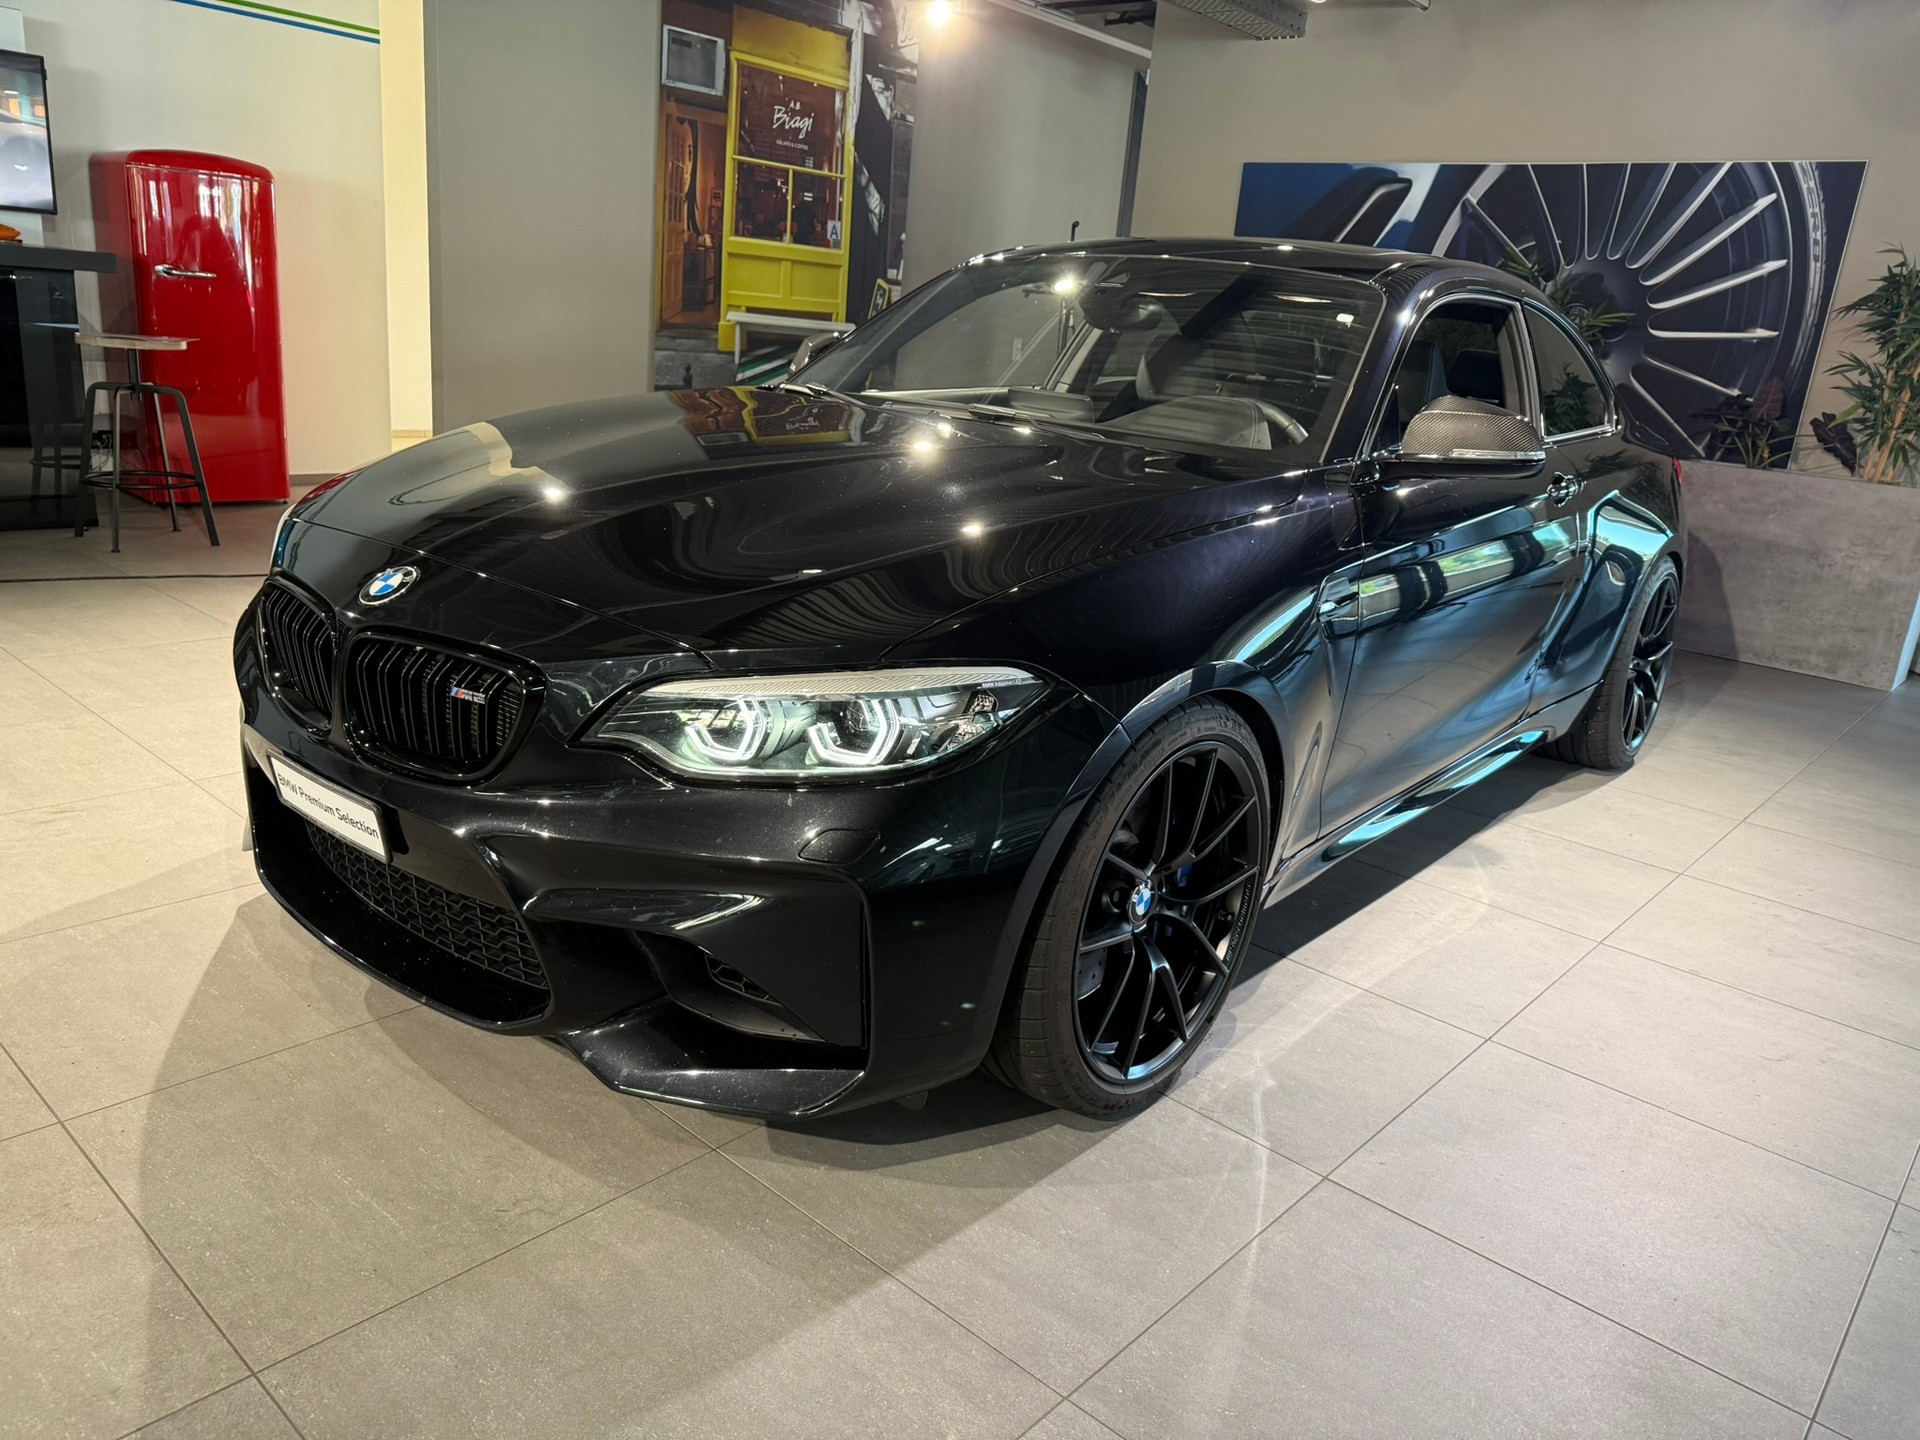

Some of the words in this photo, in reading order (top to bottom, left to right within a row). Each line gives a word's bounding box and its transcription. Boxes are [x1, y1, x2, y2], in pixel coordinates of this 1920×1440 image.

[772, 105, 815, 139] Biagi
[830, 224, 839, 239] A
[1798, 162, 1820, 263] ZERO
[277, 773, 299, 795] BMW
[298, 786, 336, 817] Premium
[335, 807, 379, 839] Selection
